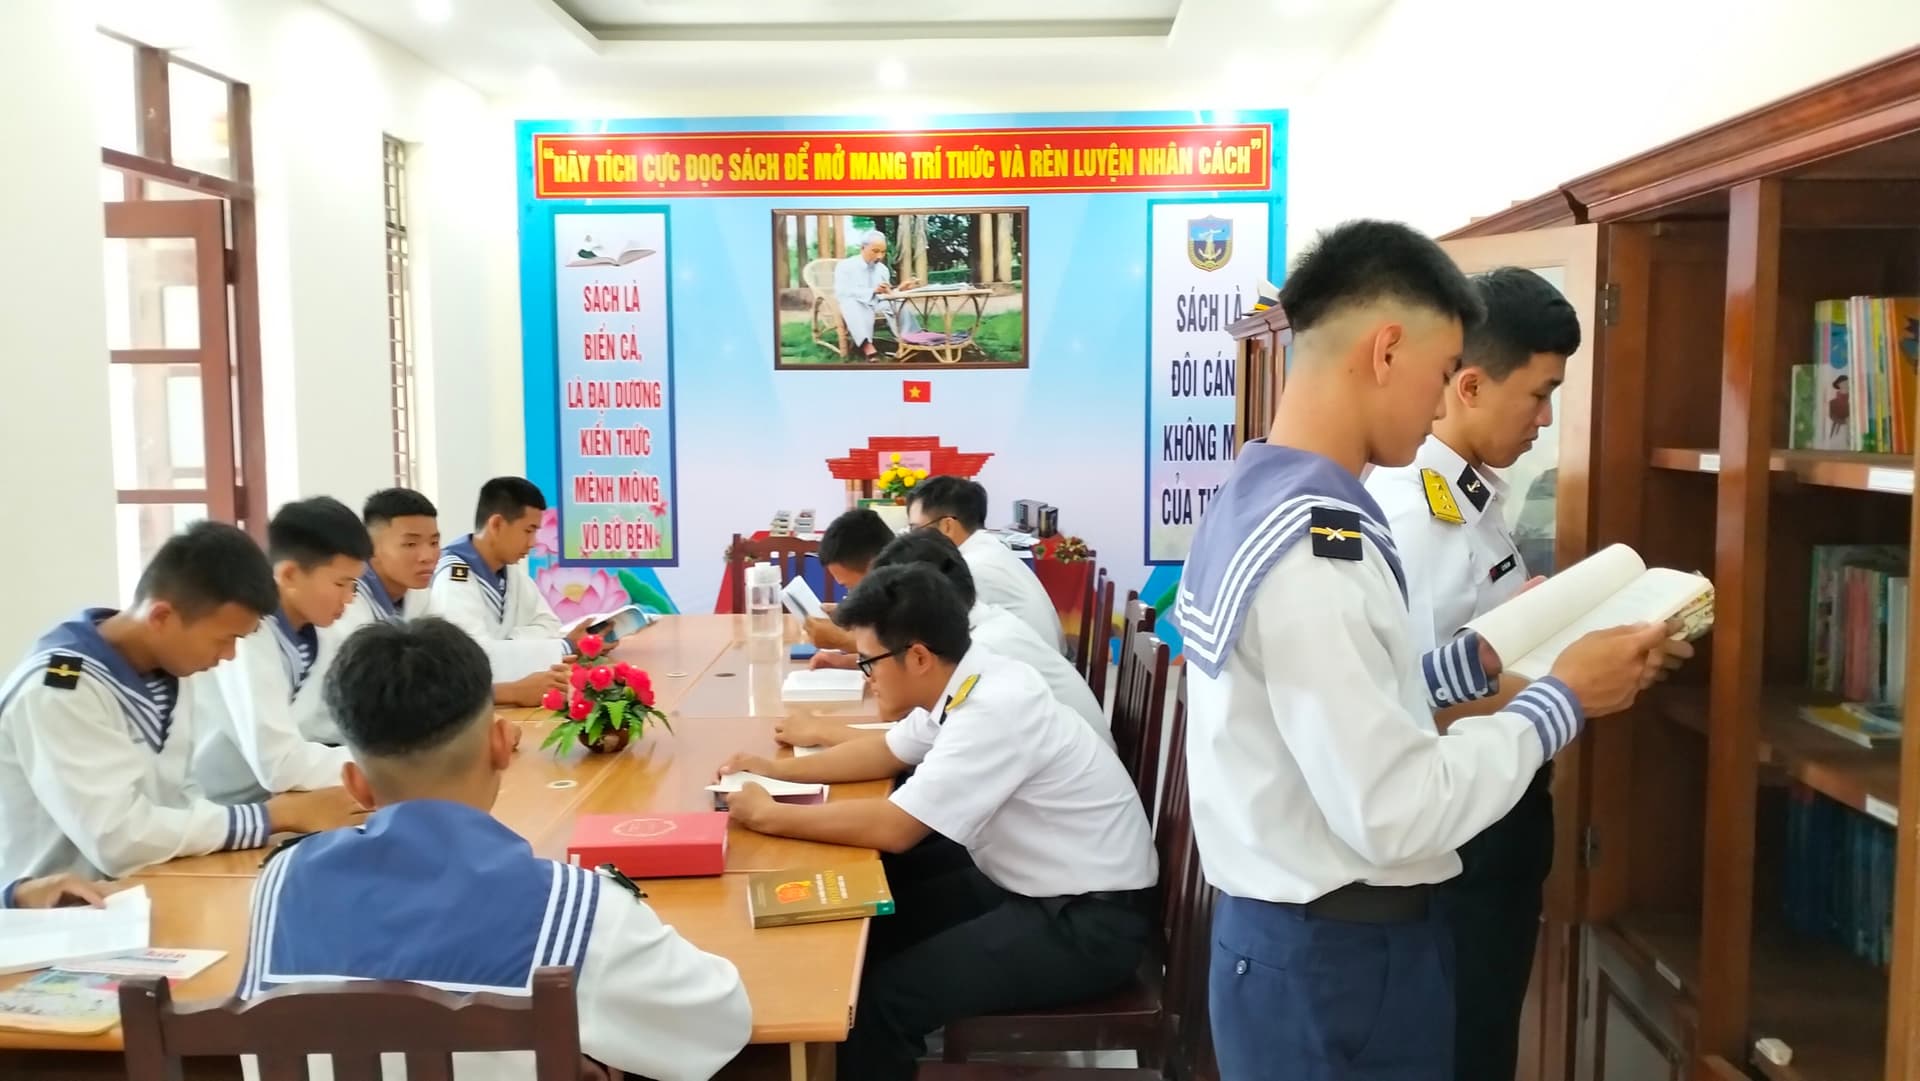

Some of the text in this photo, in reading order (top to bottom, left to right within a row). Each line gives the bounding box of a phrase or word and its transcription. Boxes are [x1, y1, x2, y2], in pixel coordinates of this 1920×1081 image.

[595, 148, 638, 182] TÍCH
[642, 151, 681, 188] CỰC
[685, 152, 724, 187] ĐỌC
[728, 147, 779, 181] SÁCH
[784, 141, 811, 181] ĐỂ
[814, 143, 846, 181] MỞ
[850, 151, 907, 180] MANG
[912, 145, 941, 180] TRÍ
[946, 146, 995, 179] THỨC
[1000, 143, 1025, 178] VÀ
[1030, 143, 1069, 178] RÈN
[1074, 142, 1131, 183] LUYỆN
[1139, 141, 1193, 176] NHÂN
[584, 280, 640, 312] SÁCH LÀ
[1177, 286, 1218, 332] SÁCH
[568, 376, 584, 408] LÀ
[588, 382, 610, 414] ĐẠI
[1171, 350, 1235, 397] ĐÔI CÁN
[1163, 416, 1217, 461] KHÔNG
[1162, 472, 1192, 525] CỦA
